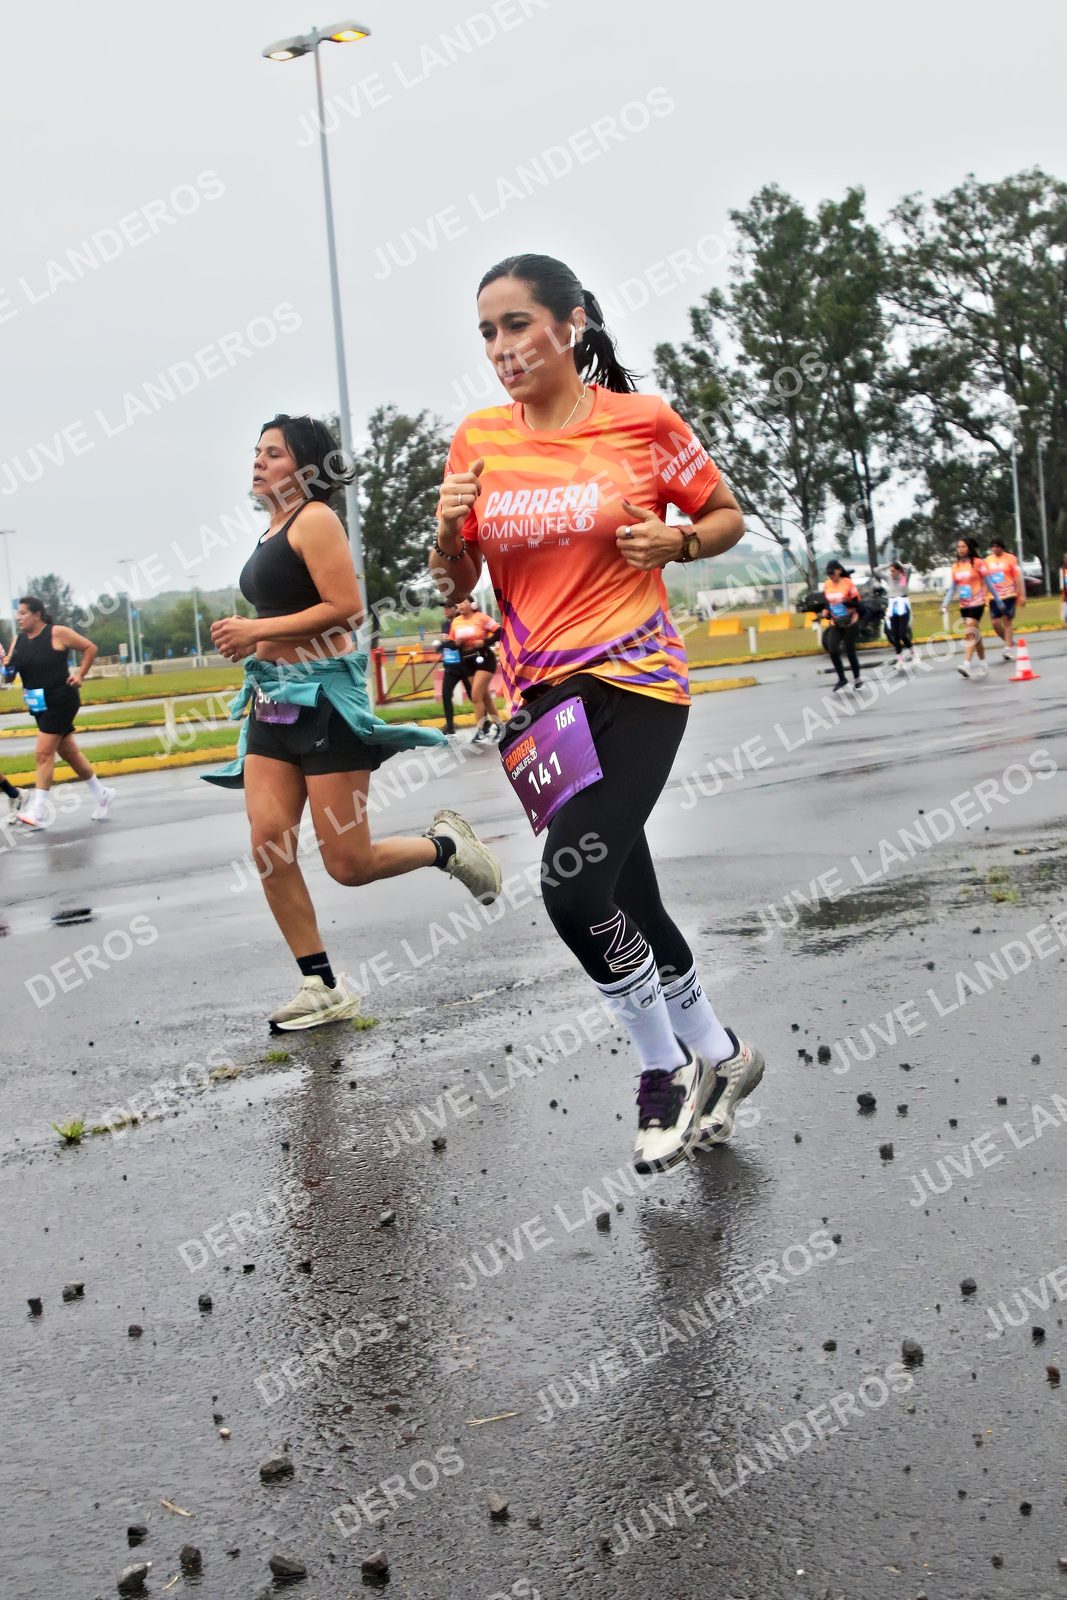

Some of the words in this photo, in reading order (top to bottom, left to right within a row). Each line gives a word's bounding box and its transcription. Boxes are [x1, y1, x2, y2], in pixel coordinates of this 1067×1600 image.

[484, 482, 599, 518] CARRERA
[481, 516, 567, 540] OMNILIFE
[505, 736, 536, 772] CARRERA
[528, 751, 562, 795] 141
